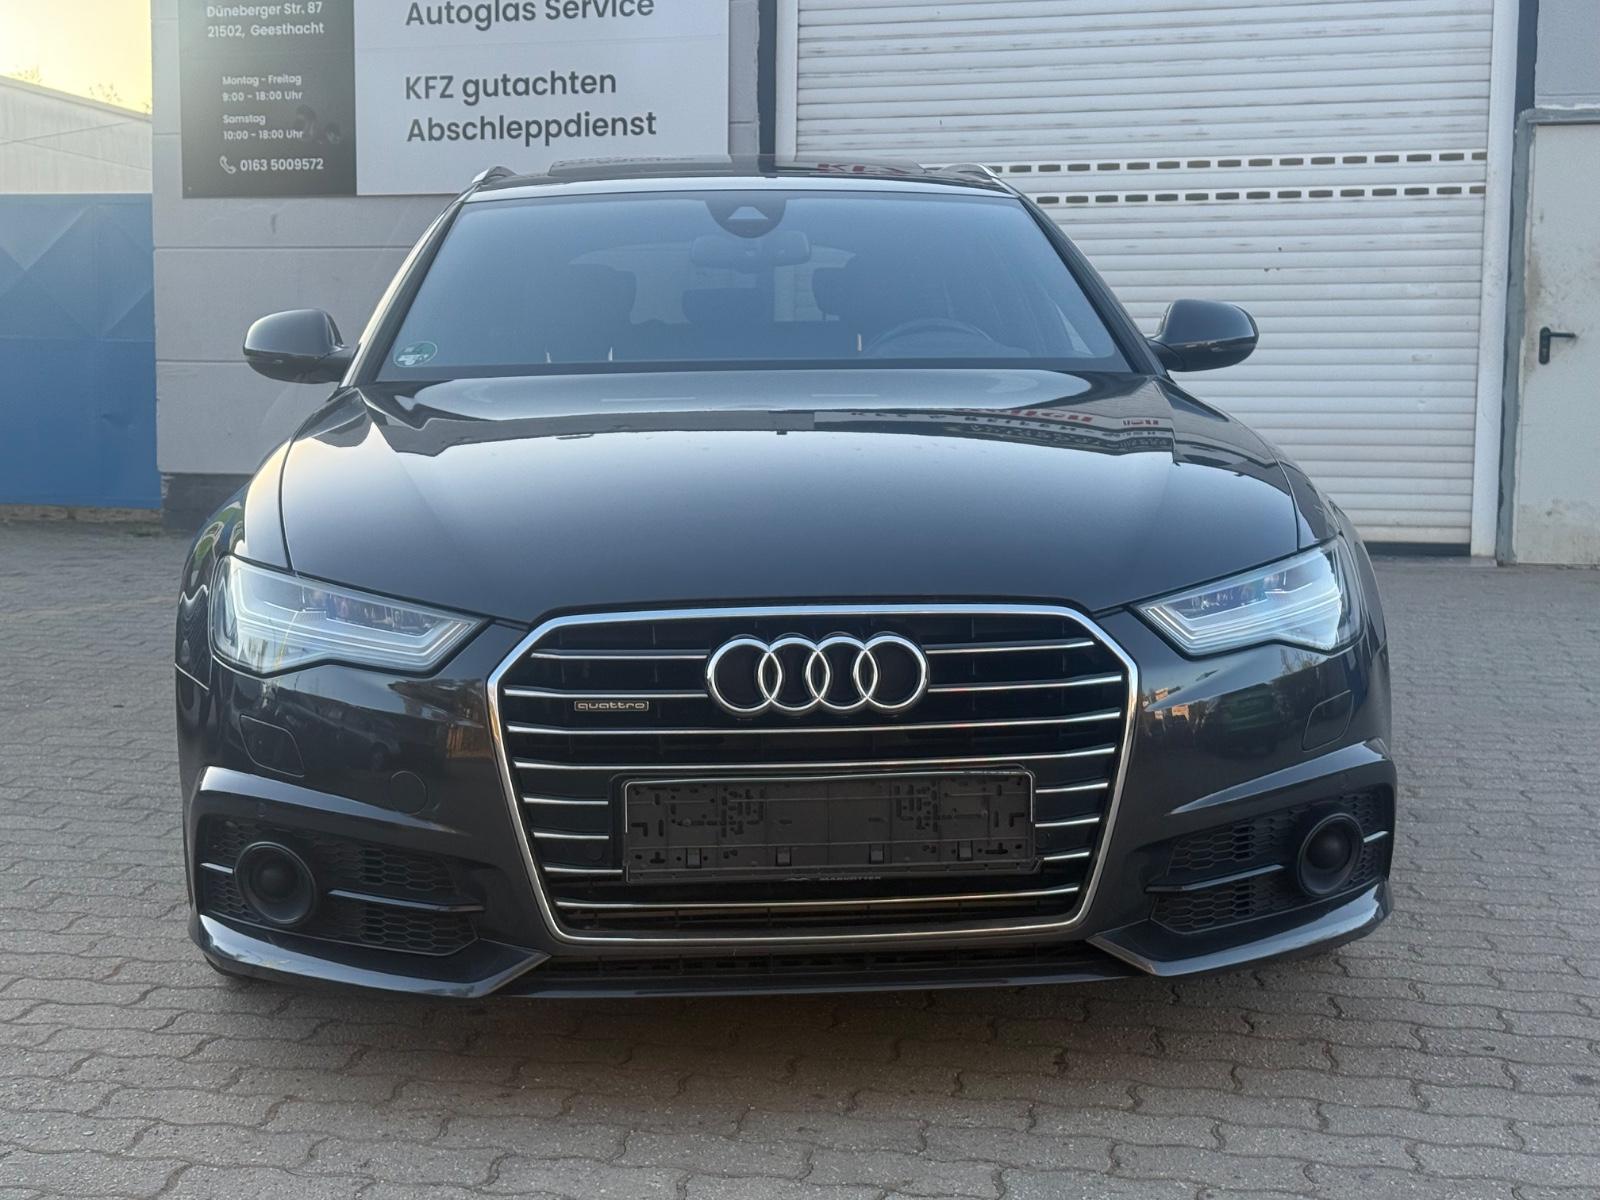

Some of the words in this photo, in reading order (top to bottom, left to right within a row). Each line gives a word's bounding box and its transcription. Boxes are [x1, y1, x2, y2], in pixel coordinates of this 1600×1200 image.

[207, 5, 281, 19] Düneberger
[283, 3, 305, 15] Str.
[307, 1, 323, 14] 87
[405, 0, 536, 31] Autoglas
[545, 0, 654, 20] Service
[207, 25, 246, 38] 21502,
[250, 22, 325, 36] Geesthacht
[222, 75, 259, 87] Montag
[268, 74, 302, 86] Freitag
[255, 90, 282, 101] 18:00
[284, 90, 303, 100] Uhr
[405, 75, 454, 100] KFZ
[462, 71, 616, 106] gutachten
[223, 114, 266, 126] Samstag
[223, 130, 249, 140] 10:00
[259, 129, 284, 139] 18:00
[286, 129, 304, 139] Uhr
[406, 111, 657, 147] Abschleppdienst
[239, 159, 268, 172] 0163
[270, 158, 324, 171] 5009572
[577, 701, 645, 710] quattro
